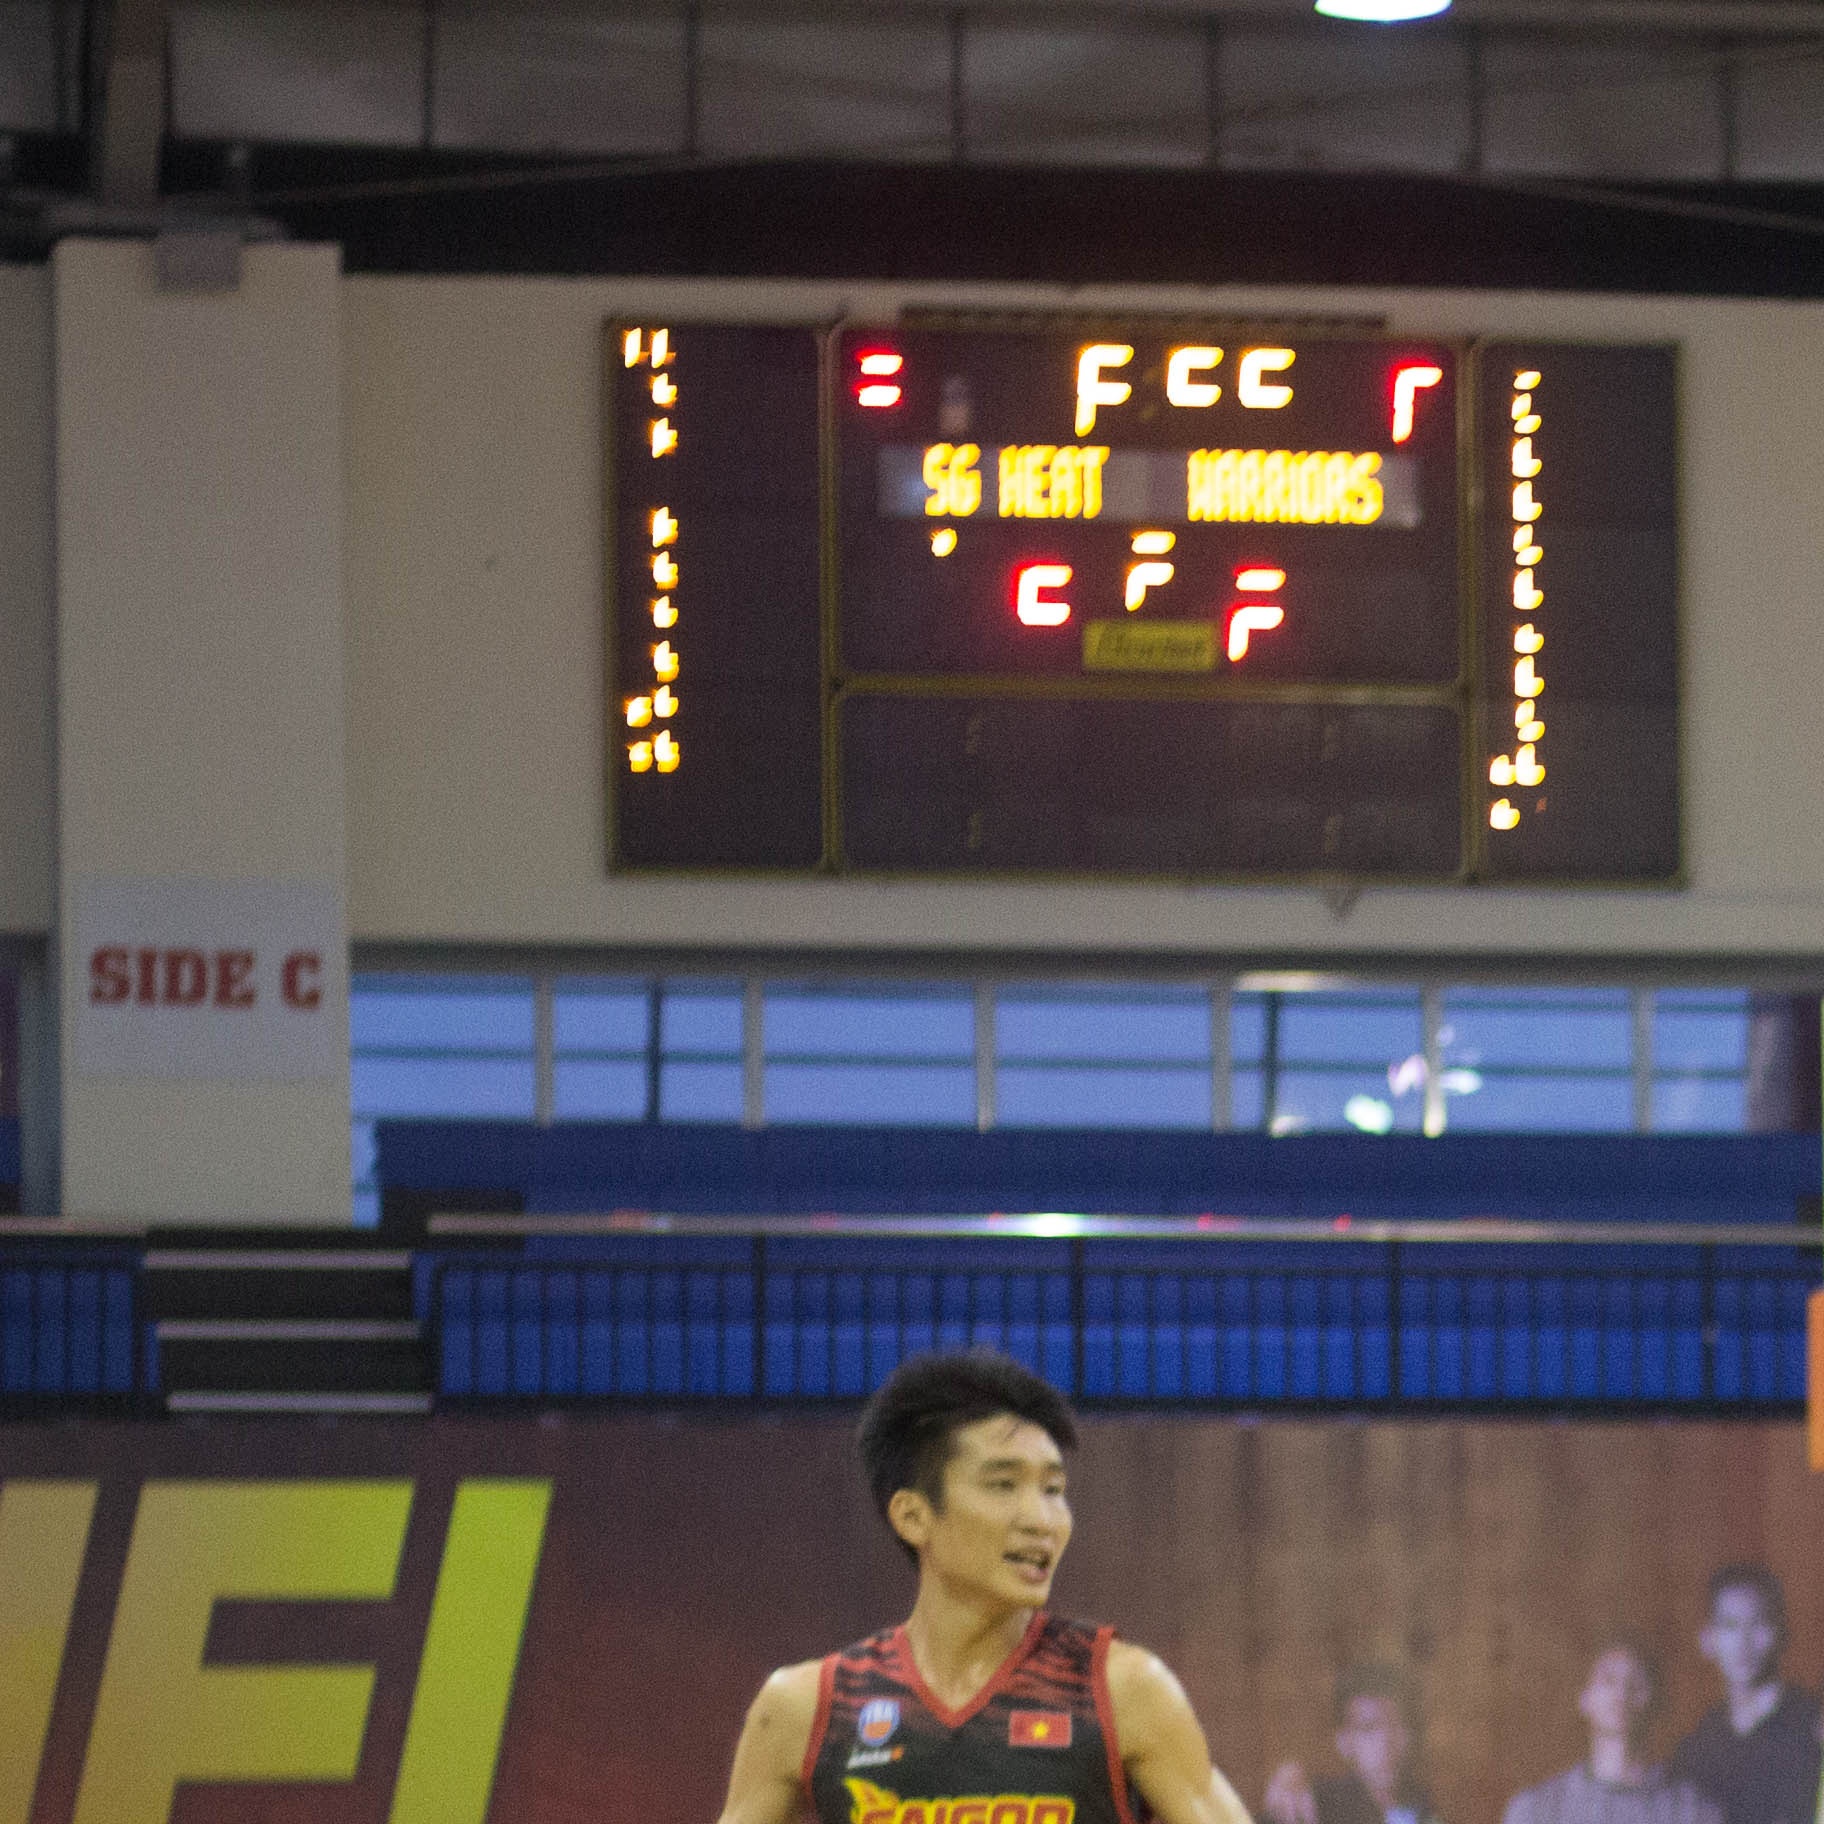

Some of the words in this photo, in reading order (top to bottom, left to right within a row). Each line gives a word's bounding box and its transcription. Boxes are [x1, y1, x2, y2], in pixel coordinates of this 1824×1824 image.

[922, 443, 982, 517] SG
[998, 445, 1110, 518] HEAT
[89, 947, 256, 1010] SIDE
[280, 948, 321, 1010] C
